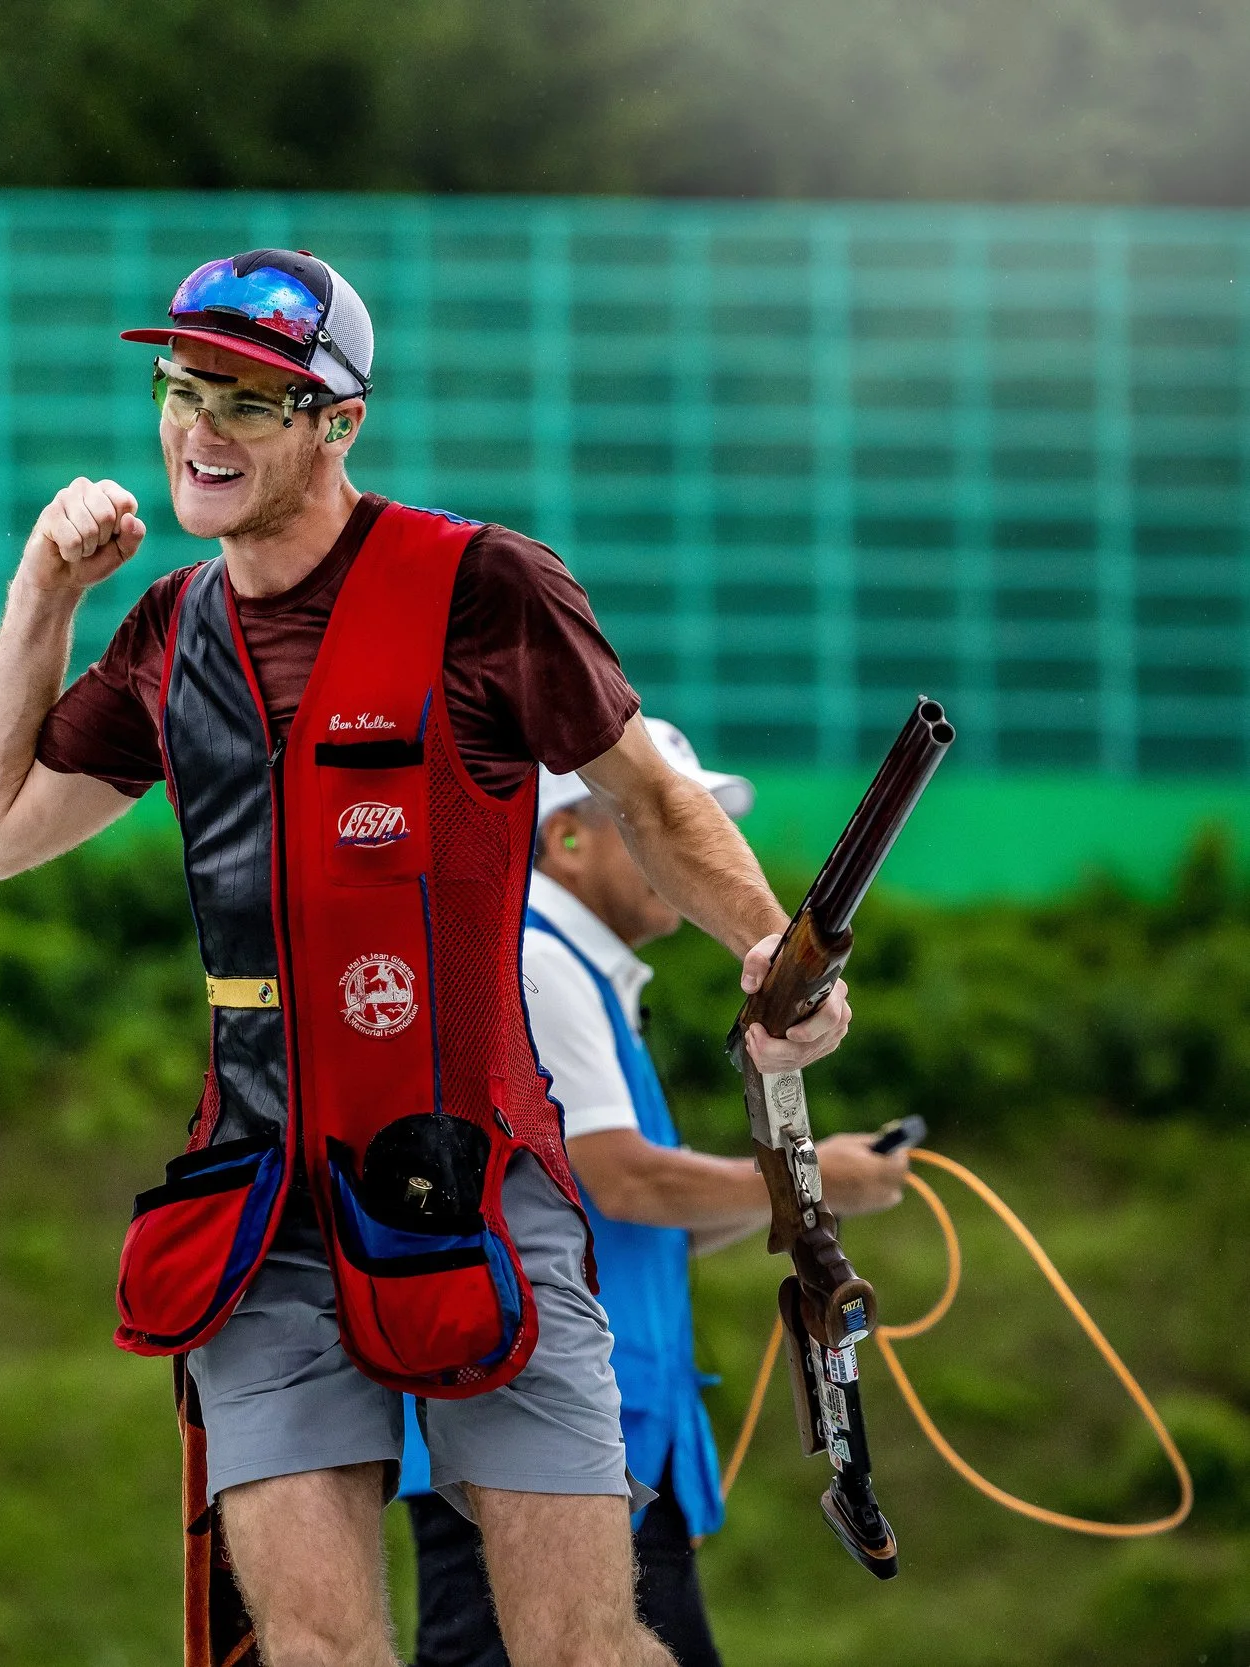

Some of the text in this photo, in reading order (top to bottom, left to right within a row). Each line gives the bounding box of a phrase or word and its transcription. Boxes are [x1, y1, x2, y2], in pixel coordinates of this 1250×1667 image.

[329, 712, 396, 731] Ben Keller
[341, 807, 403, 838] USA
[339, 952, 416, 987] The Hal & Jean Glassen
[348, 1003, 419, 1037] Memorial Foundation
[841, 1298, 861, 1314] 2022
